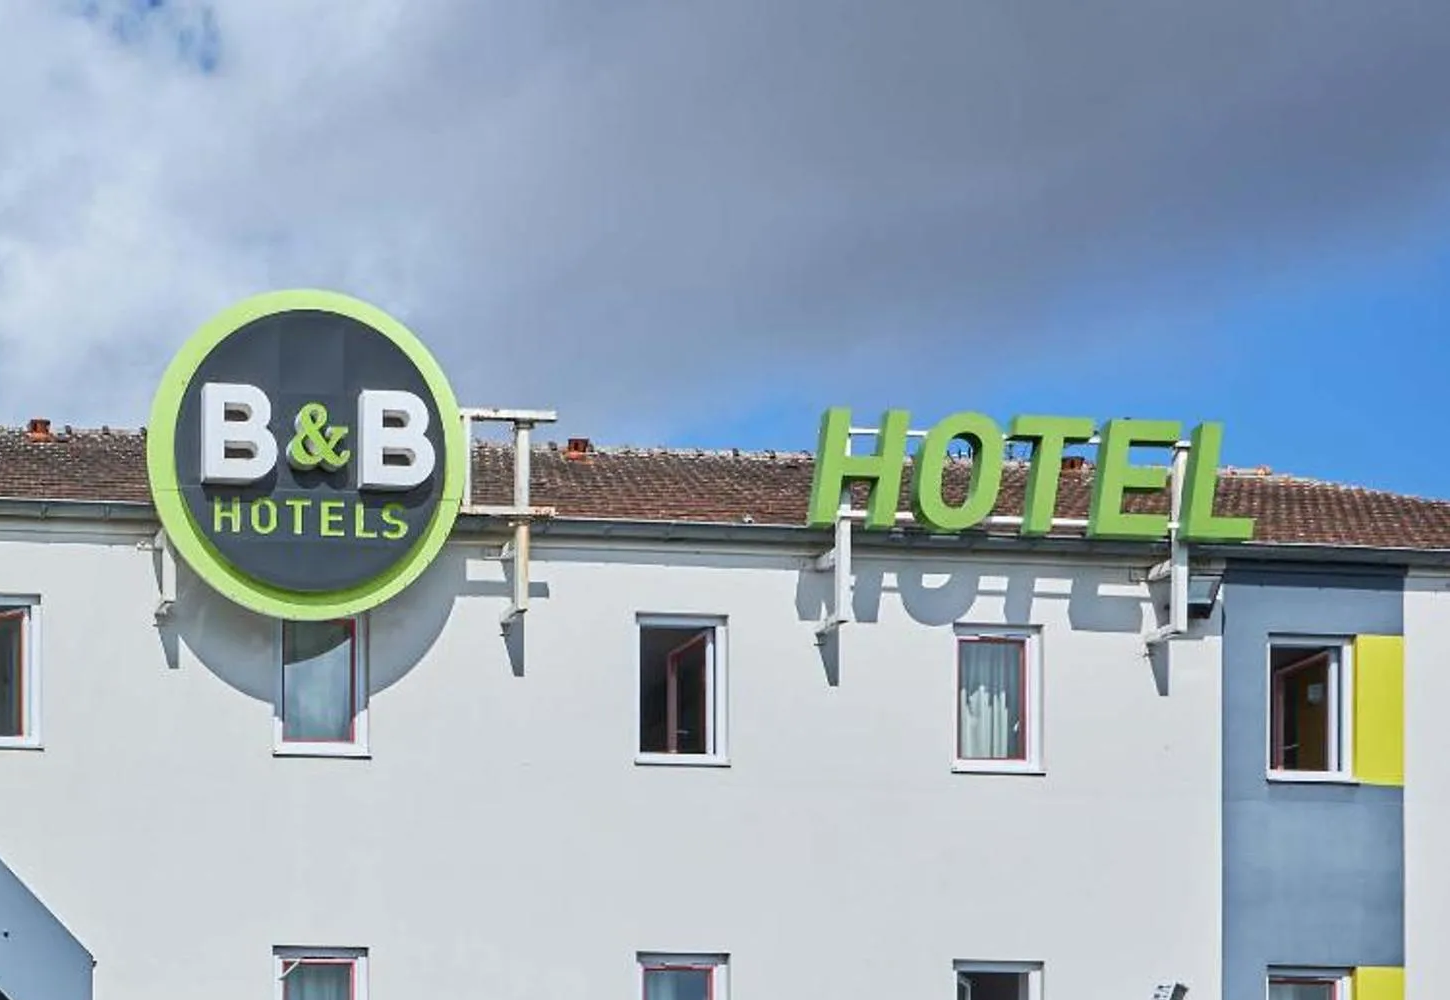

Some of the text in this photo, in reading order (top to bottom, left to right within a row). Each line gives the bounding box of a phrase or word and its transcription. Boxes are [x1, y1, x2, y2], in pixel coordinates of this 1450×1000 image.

[201, 382, 436, 491] B&B
[807, 406, 1255, 543] HOTEL
[213, 496, 409, 540] HOTELS
